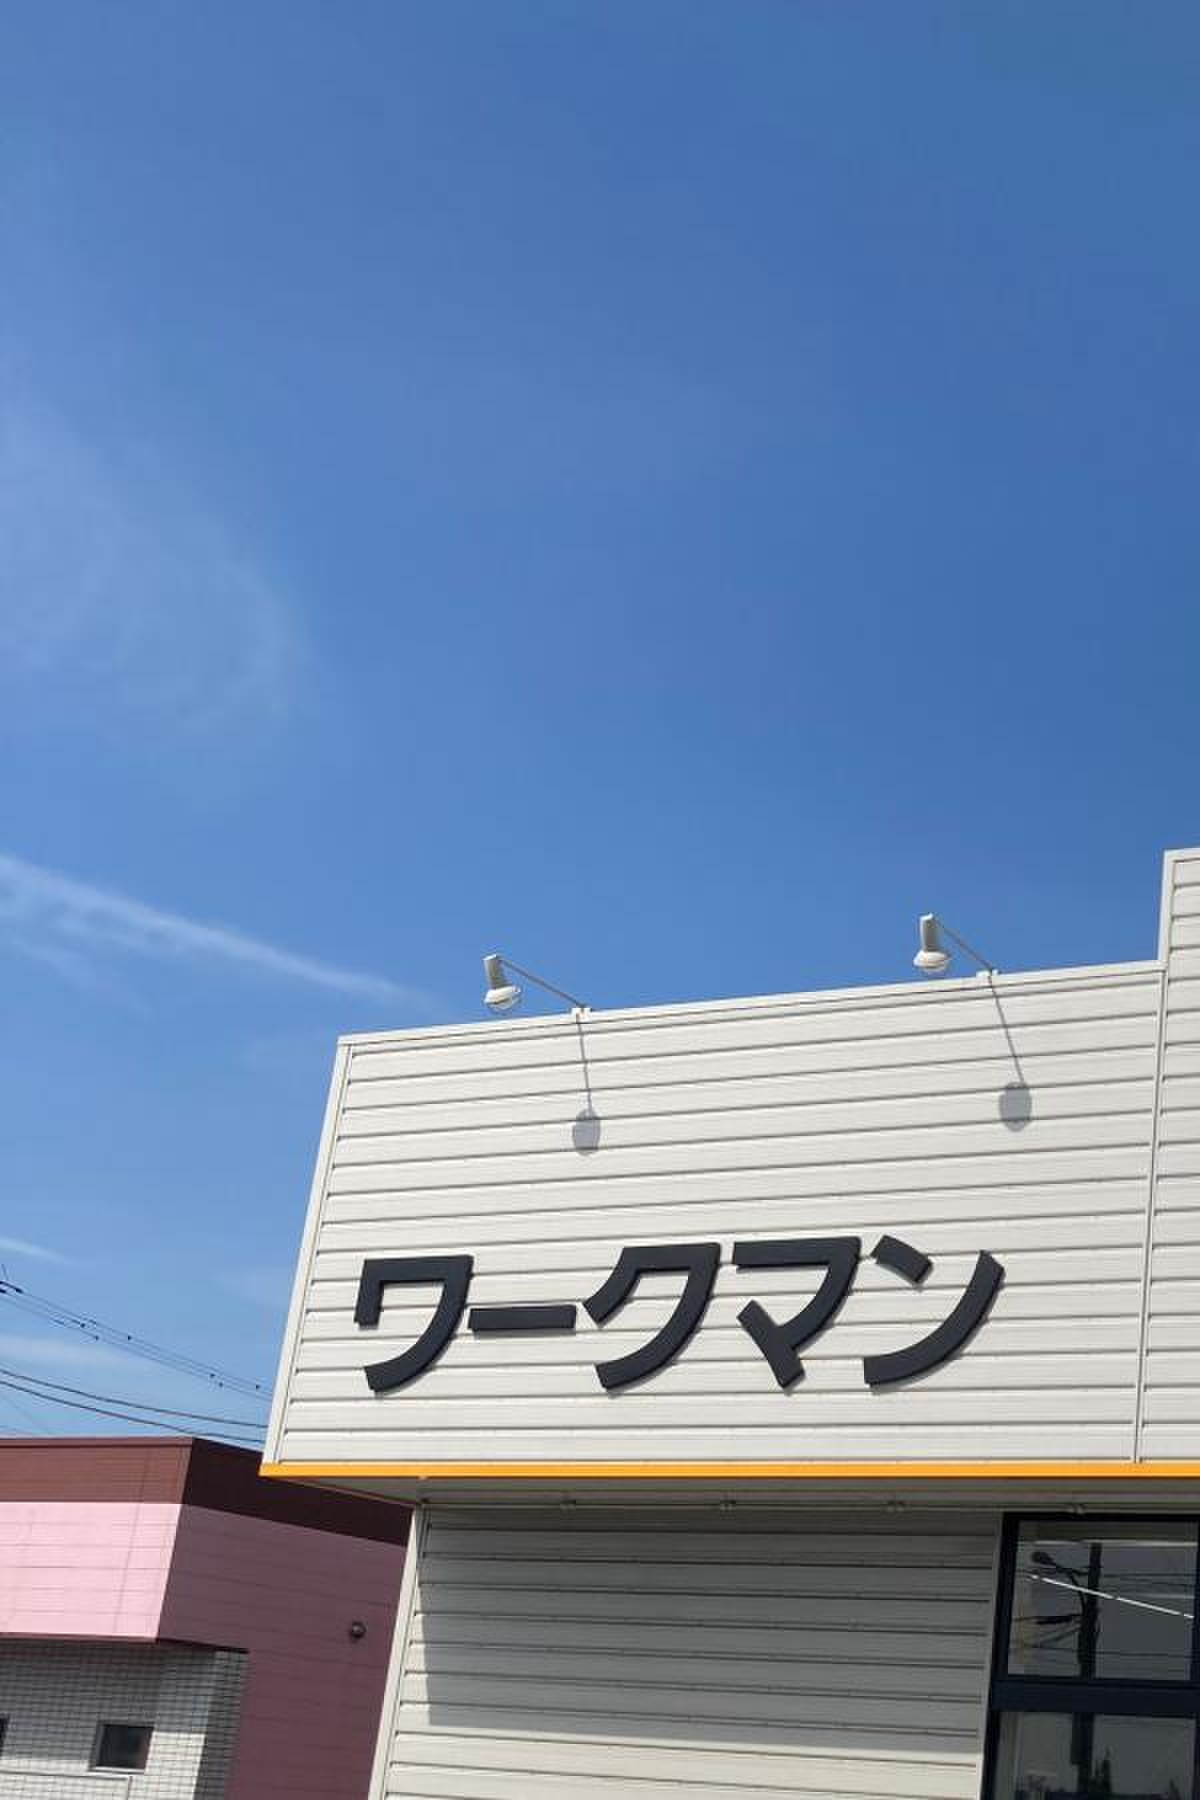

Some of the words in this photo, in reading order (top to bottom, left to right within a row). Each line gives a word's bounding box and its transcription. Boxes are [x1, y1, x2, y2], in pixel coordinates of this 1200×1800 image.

[354, 1235, 1004, 1393] ワークマン
